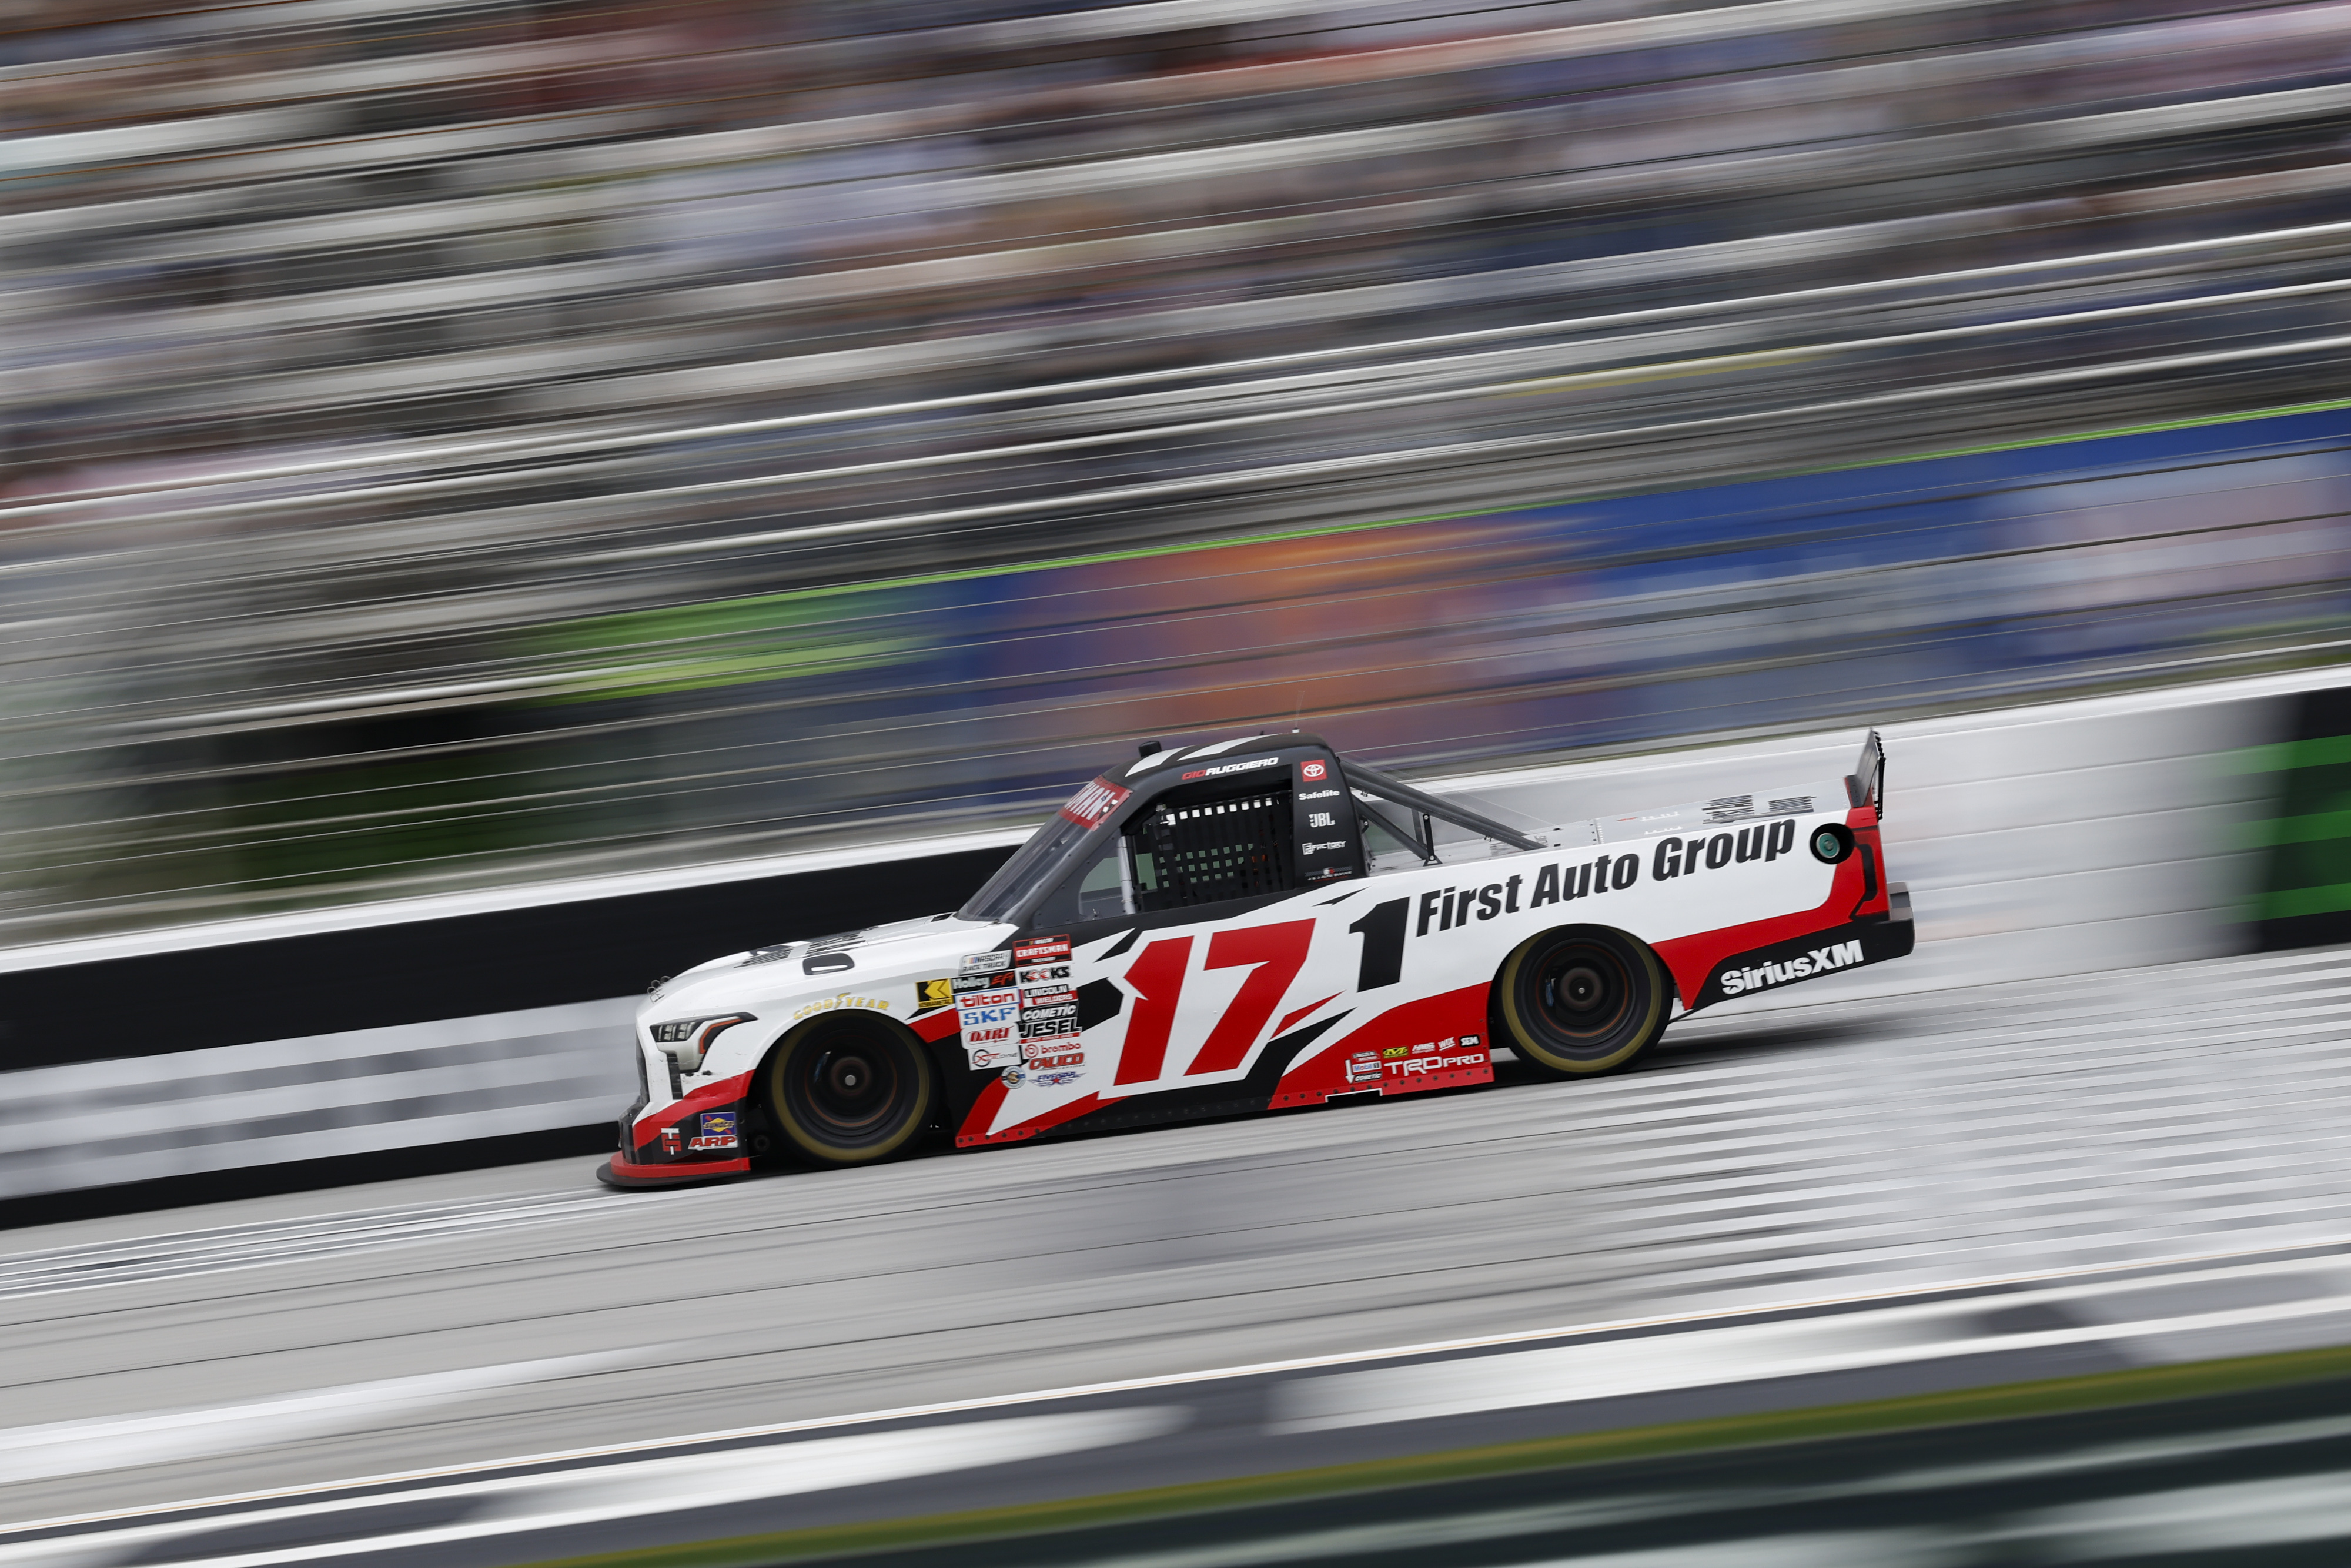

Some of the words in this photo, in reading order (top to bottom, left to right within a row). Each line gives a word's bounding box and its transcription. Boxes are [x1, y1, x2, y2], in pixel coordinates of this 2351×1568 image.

[1182, 770, 1206, 780] GIO
[1205, 757, 1279, 776] RUGGIERO
[1299, 790, 1340, 800] Safelite
[1309, 812, 1336, 828] JBL
[1349, 897, 1410, 992] 1
[1416, 874, 1523, 937] First
[1530, 853, 1640, 909] Auto
[1652, 818, 1795, 881] Group
[1016, 944, 1069, 957] CRAFTSMAN
[1020, 966, 1071, 983] KOOKS
[1721, 939, 1865, 995] SiriusXM
[952, 977, 991, 989] Holley
[1025, 985, 1068, 998] LINCOLN
[1035, 994, 1073, 1004] WELDERS
[960, 993, 1015, 1008] tilton
[1112, 917, 1317, 1086] 17
[964, 1007, 1016, 1025] SKF
[1022, 1004, 1077, 1021] COMETIC
[1019, 1018, 1082, 1038] JESEL
[1041, 1042, 1081, 1054] brembo
[1412, 1042, 1435, 1051] HMS
[1438, 1037, 1455, 1048] WIX
[1460, 1036, 1479, 1046] SEM
[1029, 1052, 1085, 1070] CALICO
[1384, 1056, 1443, 1076] TRD
[690, 1136, 737, 1147] ARP
